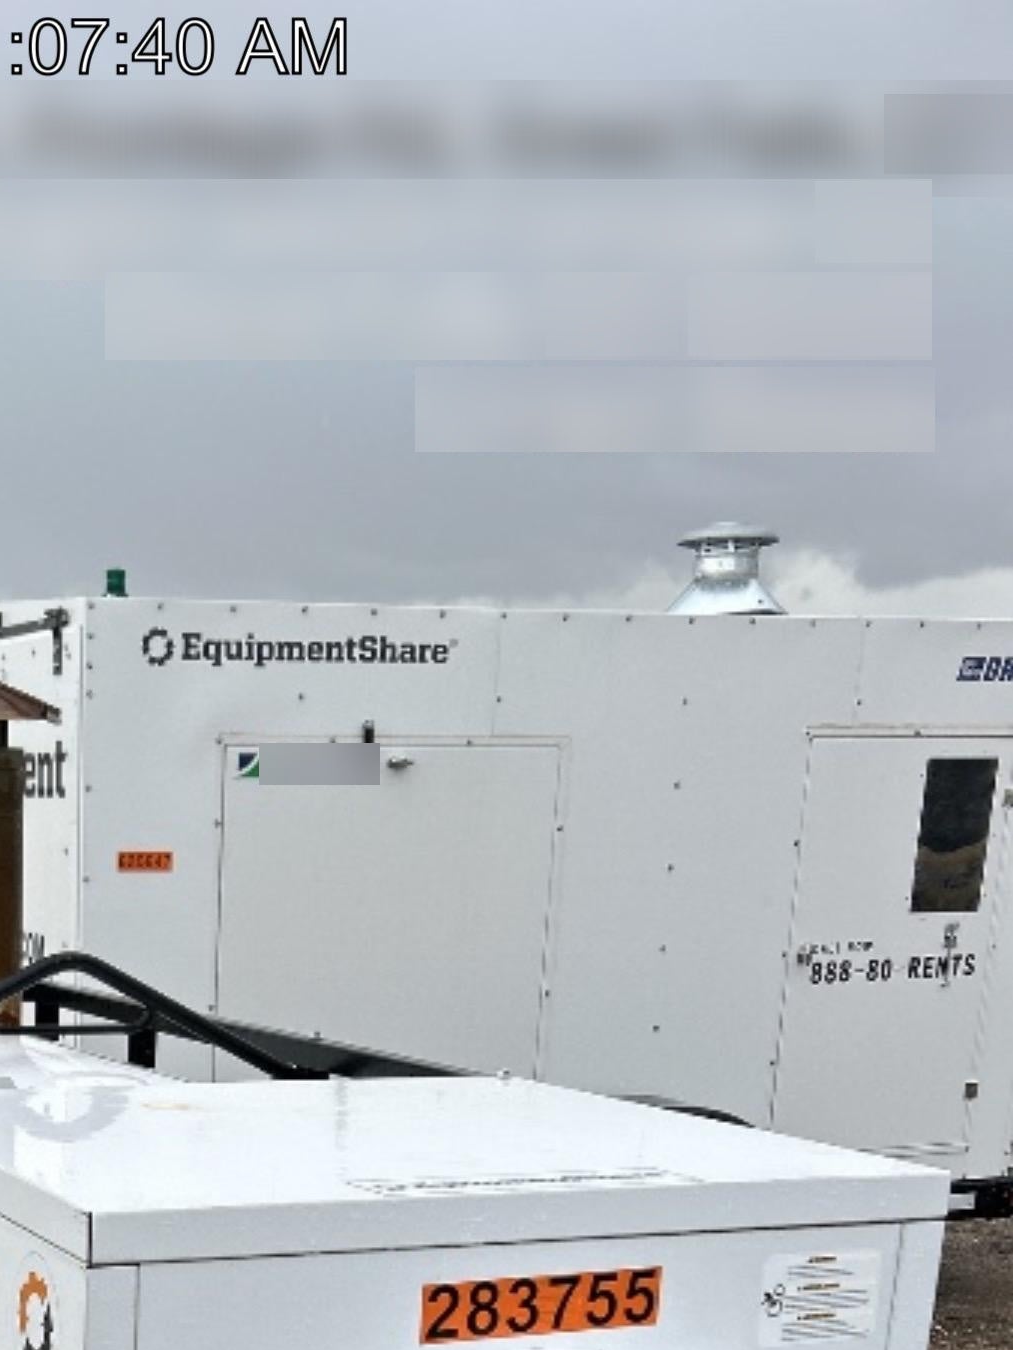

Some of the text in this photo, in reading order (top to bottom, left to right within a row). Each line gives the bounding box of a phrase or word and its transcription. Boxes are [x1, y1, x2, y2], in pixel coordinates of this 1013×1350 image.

[181, 632, 449, 667] EquipmentShare
[24, 741, 67, 799] ent
[425, 1271, 656, 1340] 283755
